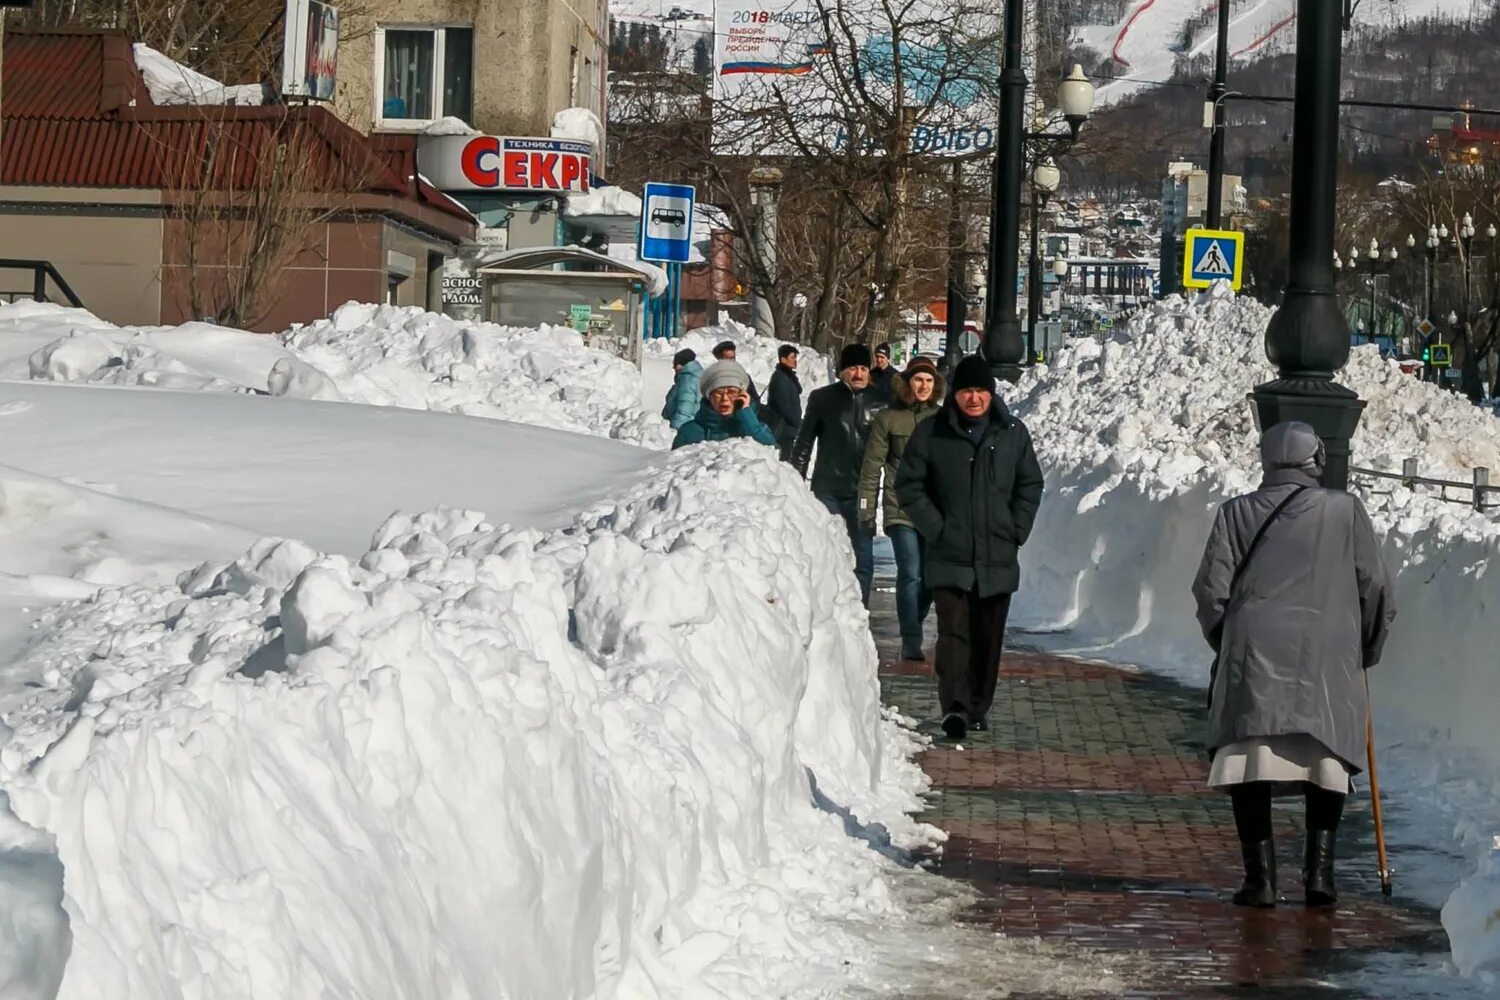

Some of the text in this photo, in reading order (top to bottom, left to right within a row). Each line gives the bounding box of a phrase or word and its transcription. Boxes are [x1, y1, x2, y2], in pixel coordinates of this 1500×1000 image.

[729, 27, 767, 35] ВЫБОРЫ
[911, 126, 993, 151] ВЫБО
[508, 140, 554, 149] ТЕХНИКА
[461, 136, 590, 193] СЕКРЕ
[442, 278, 483, 288] аснос
